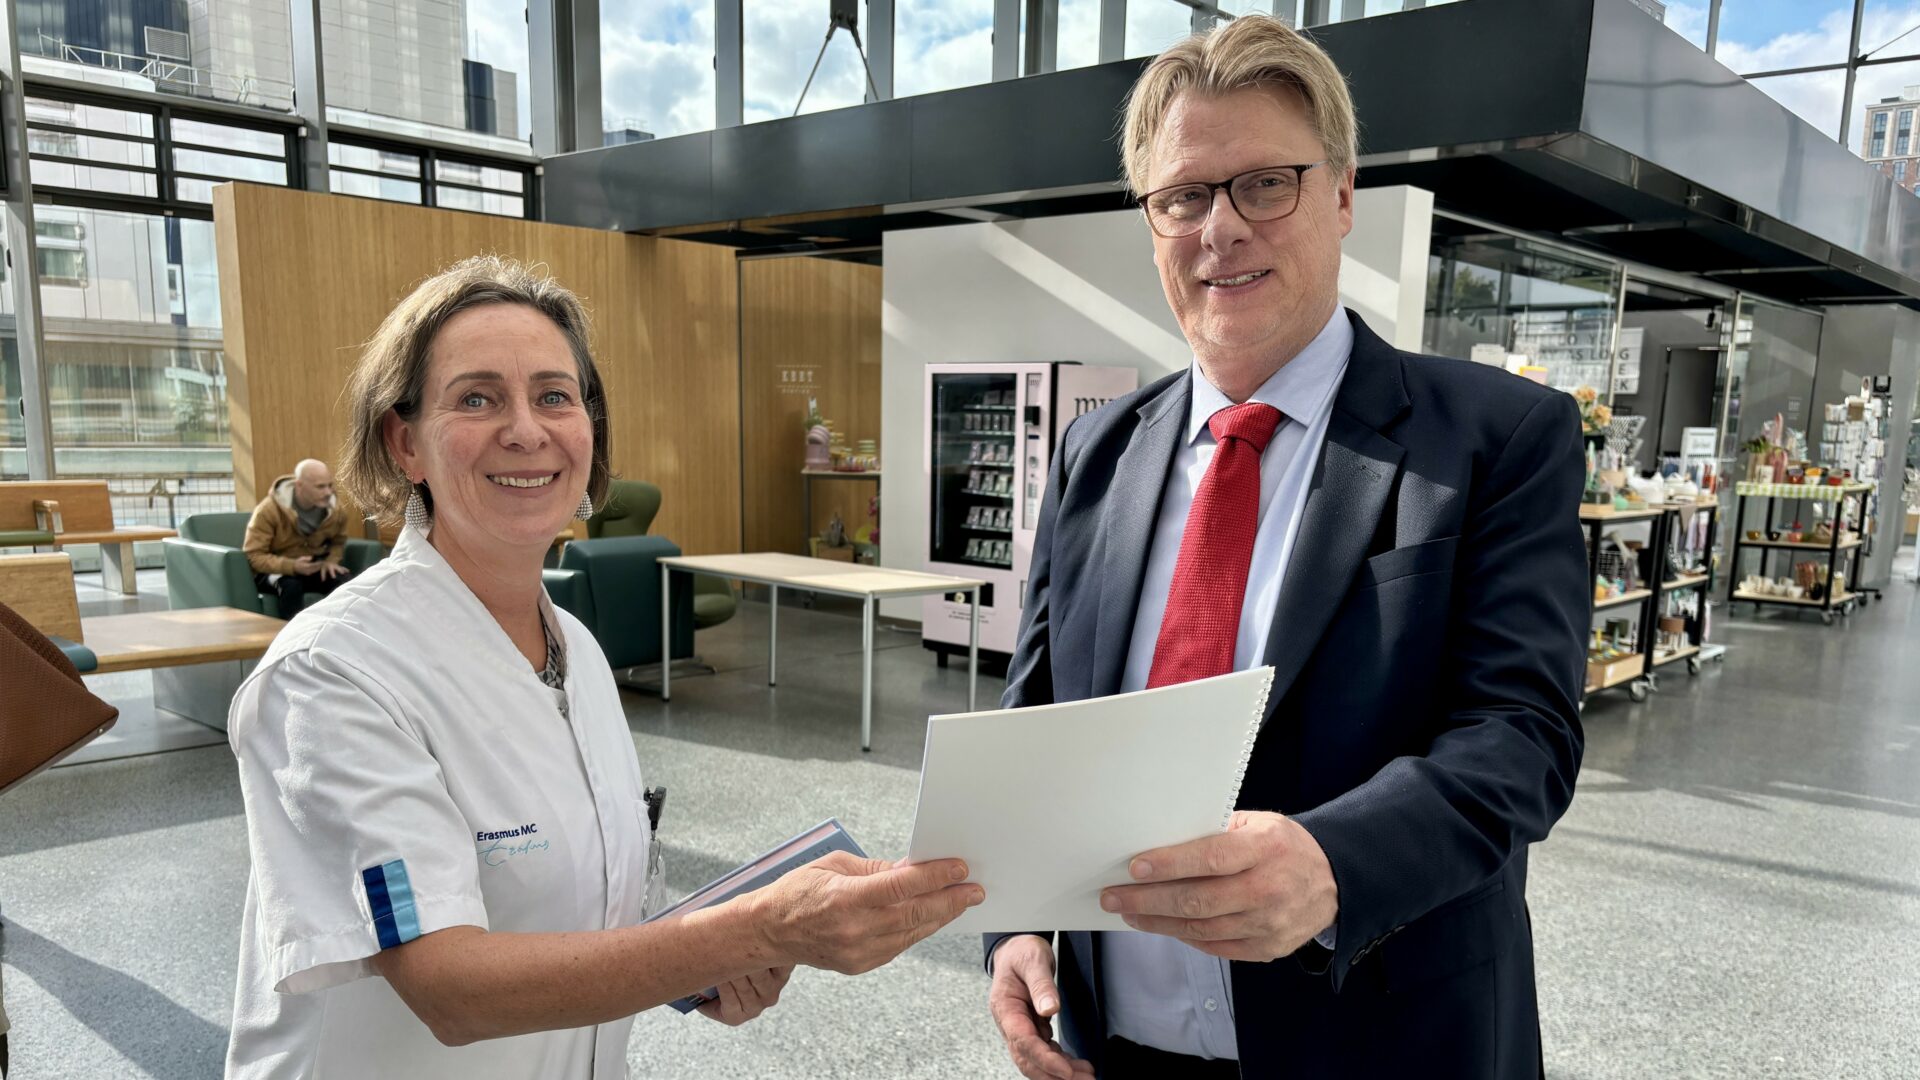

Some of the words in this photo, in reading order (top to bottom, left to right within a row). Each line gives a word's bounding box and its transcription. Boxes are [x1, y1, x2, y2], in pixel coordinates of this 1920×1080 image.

[1590, 347, 1629, 360] LOG
[476, 828, 520, 842] Erasmus
[520, 823, 538, 836] MC
